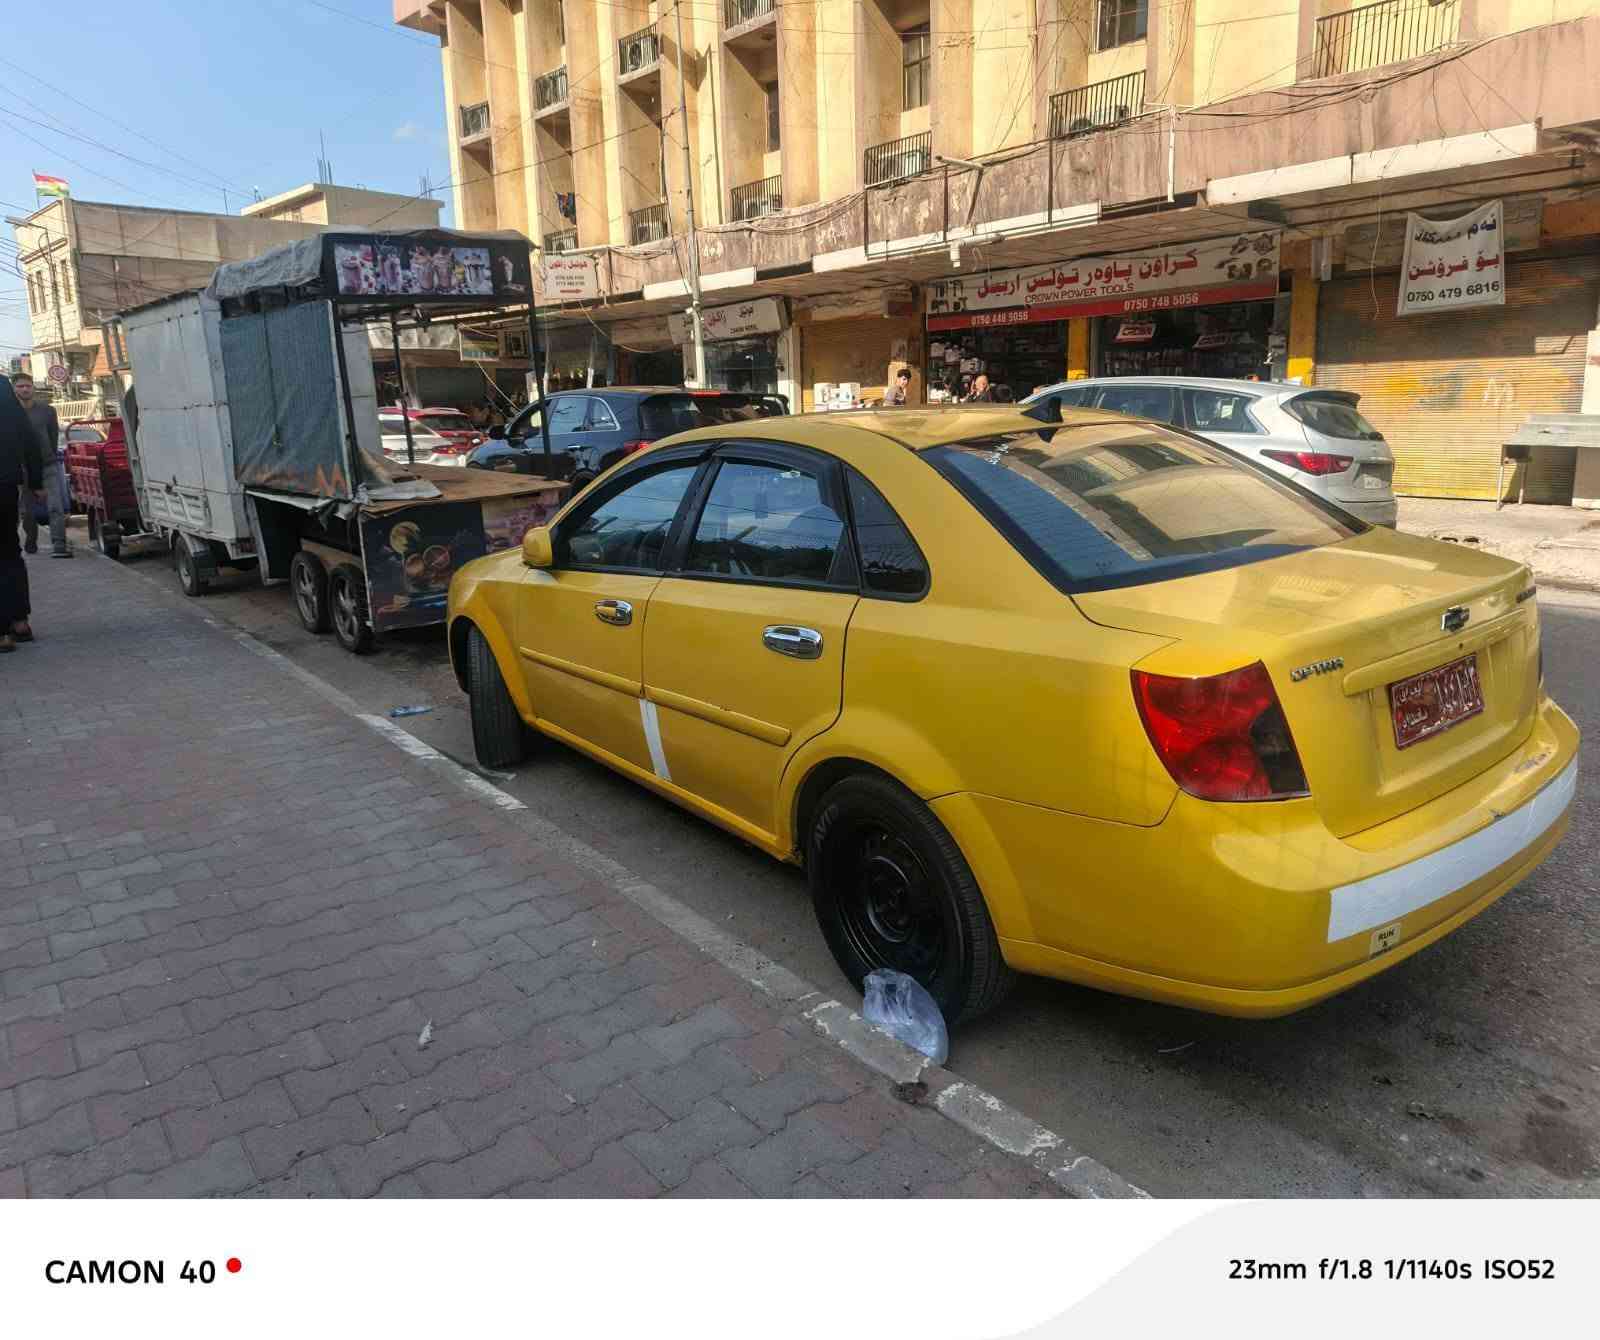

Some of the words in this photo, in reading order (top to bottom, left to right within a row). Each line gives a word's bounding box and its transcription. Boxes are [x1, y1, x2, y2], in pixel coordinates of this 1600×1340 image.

[1024, 291, 1059, 304] CROWN
[1060, 287, 1097, 299] POWER
[1101, 282, 1135, 295] TOOLS
[1438, 287, 1462, 299] 479
[1124, 298, 1148, 311] 0750
[1290, 656, 1345, 683] OPTRA
[1378, 927, 1395, 941] RUN
